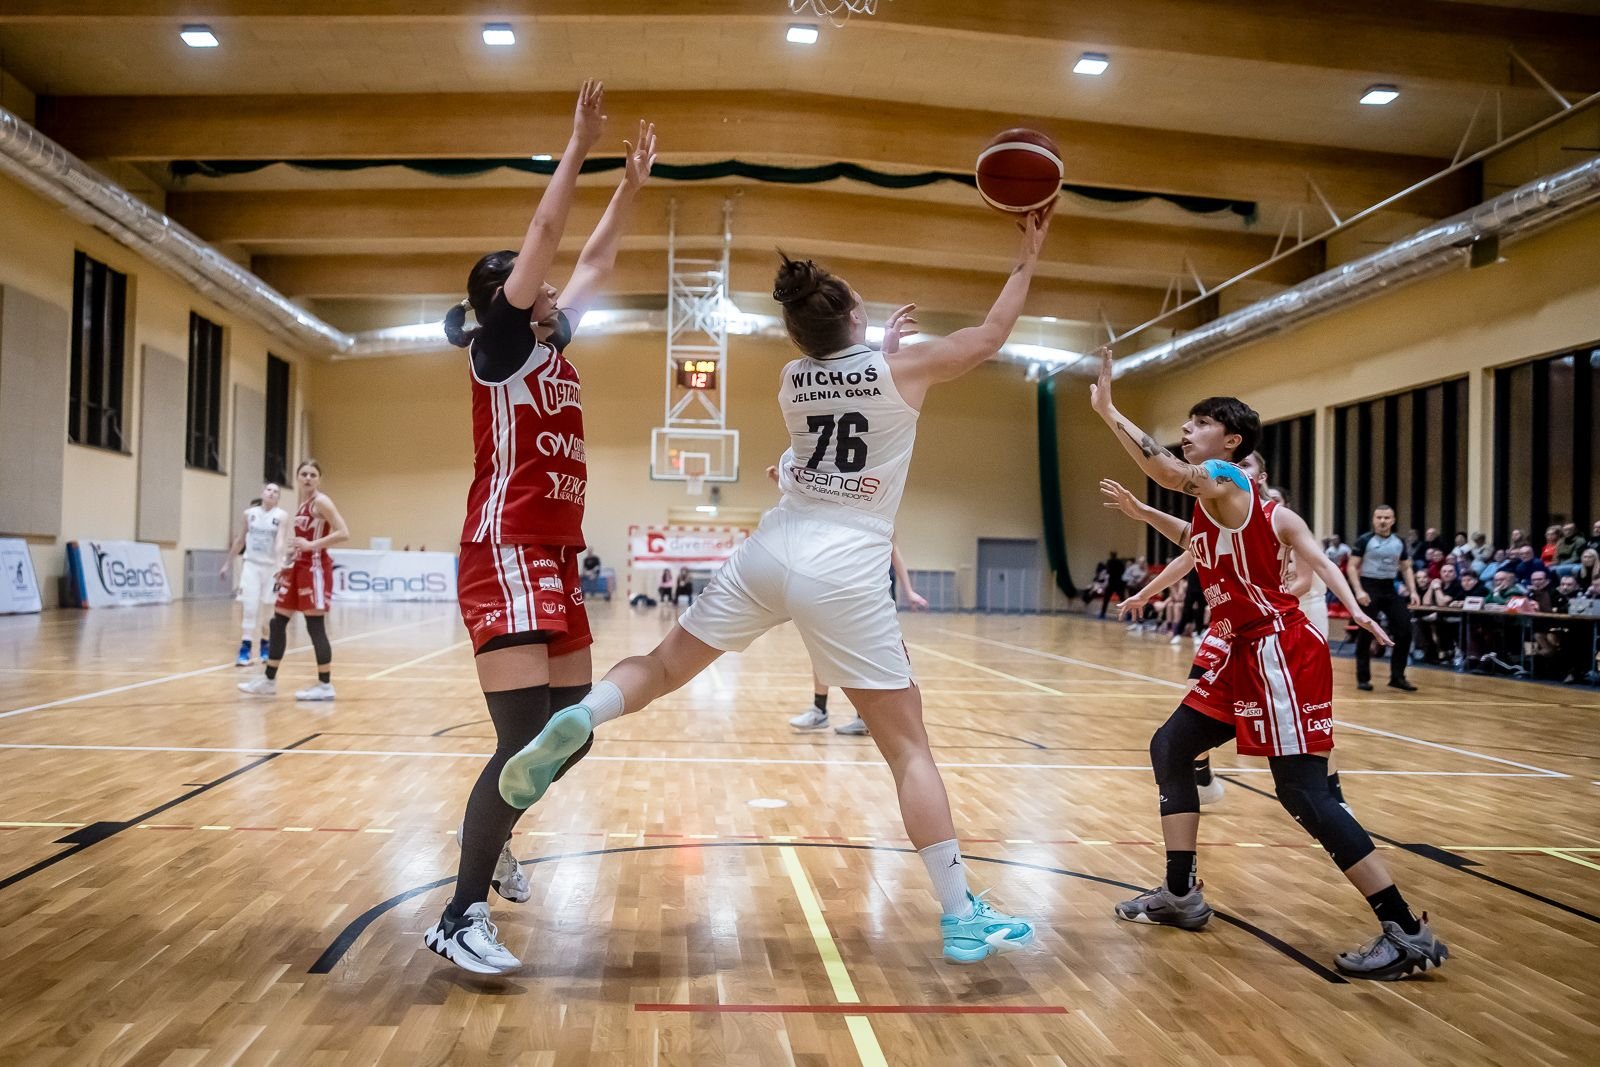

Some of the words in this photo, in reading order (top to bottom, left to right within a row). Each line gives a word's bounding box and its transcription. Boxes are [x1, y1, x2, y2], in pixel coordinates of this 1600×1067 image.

[691, 373, 707, 388] 12
[792, 364, 878, 389] WICHOŚ
[543, 380, 581, 411] OSTRO
[792, 390, 841, 403] JELENIA
[845, 387, 881, 398] GÓRA
[806, 411, 869, 473] 76
[339, 571, 447, 593] iSandS
[1254, 720, 1267, 744] 7
